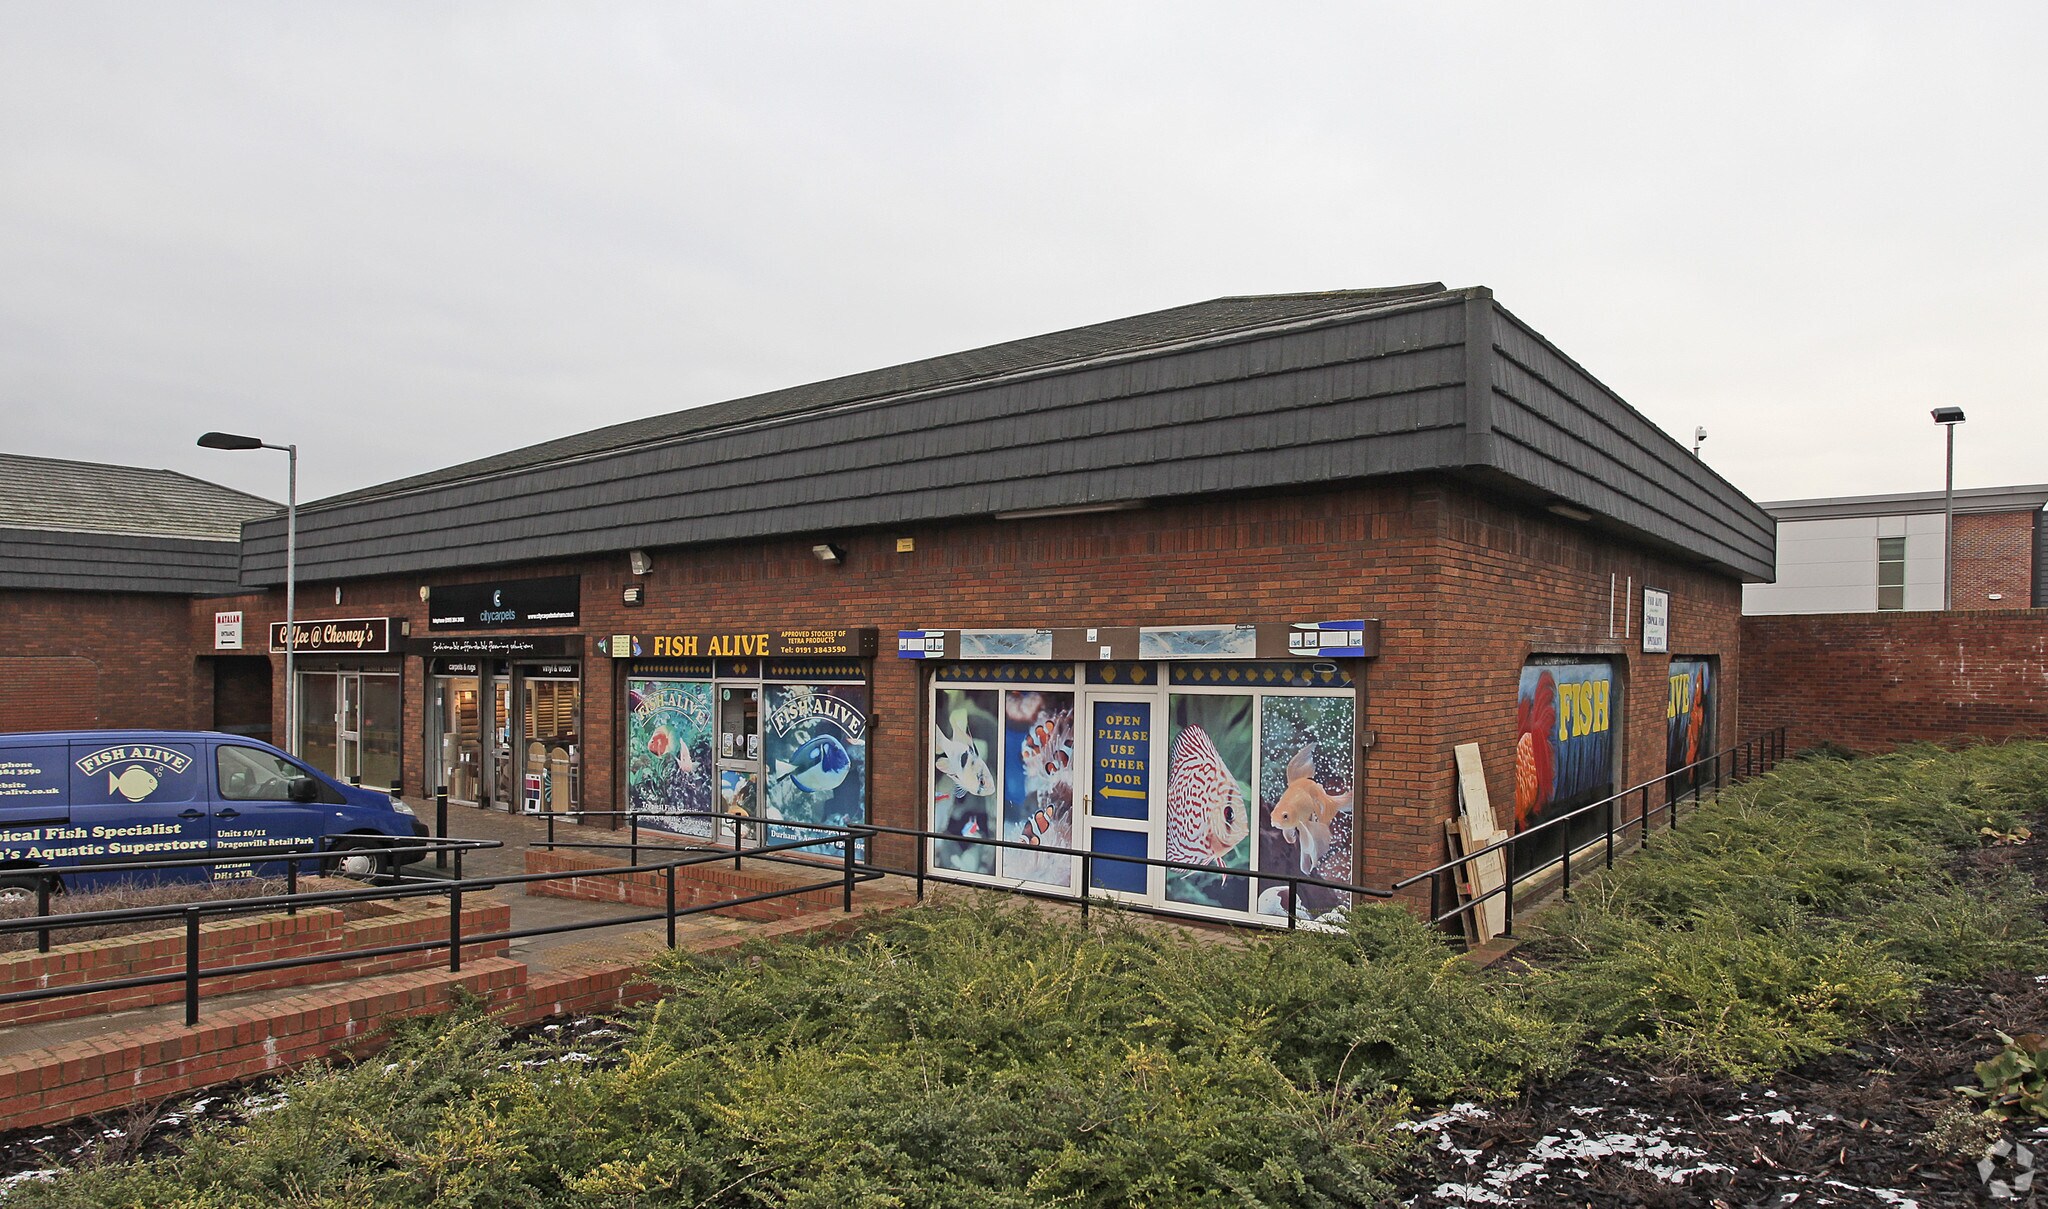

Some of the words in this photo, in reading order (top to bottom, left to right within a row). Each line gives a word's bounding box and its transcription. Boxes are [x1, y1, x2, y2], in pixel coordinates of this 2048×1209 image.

[217, 615, 240, 624] MATALAN
[480, 609, 516, 623] citycarpets
[311, 626, 322, 648] @
[323, 623, 373, 648] Chesney's
[653, 635, 698, 656] FISH
[708, 634, 770, 656] ALIVE
[638, 693, 665, 720] FISH
[668, 693, 706, 725] ALIVE
[1558, 679, 1610, 742] FISH
[1667, 673, 1690, 718] IVE
[775, 700, 808, 731] FISH
[813, 699, 861, 735] ALIVE
[1106, 715, 1141, 726] OPEN
[1098, 729, 1148, 741] PLEASE
[1110, 744, 1136, 755] USE
[82, 748, 126, 771] FISH
[130, 747, 185, 769] ALIVE
[1100, 758, 1145, 770] OTHER
[1105, 773, 1142, 785] DOOR
[45, 827, 88, 840] Fish
[92, 823, 182, 839] Specialist
[243, 829, 266, 837] 10/11
[25, 844, 105, 860] Aquatic
[108, 839, 208, 854] Superstore
[217, 840, 267, 849] Dragonville
[268, 838, 293, 846] Retail
[294, 837, 314, 845] Park
[214, 871, 232, 880] DH1
